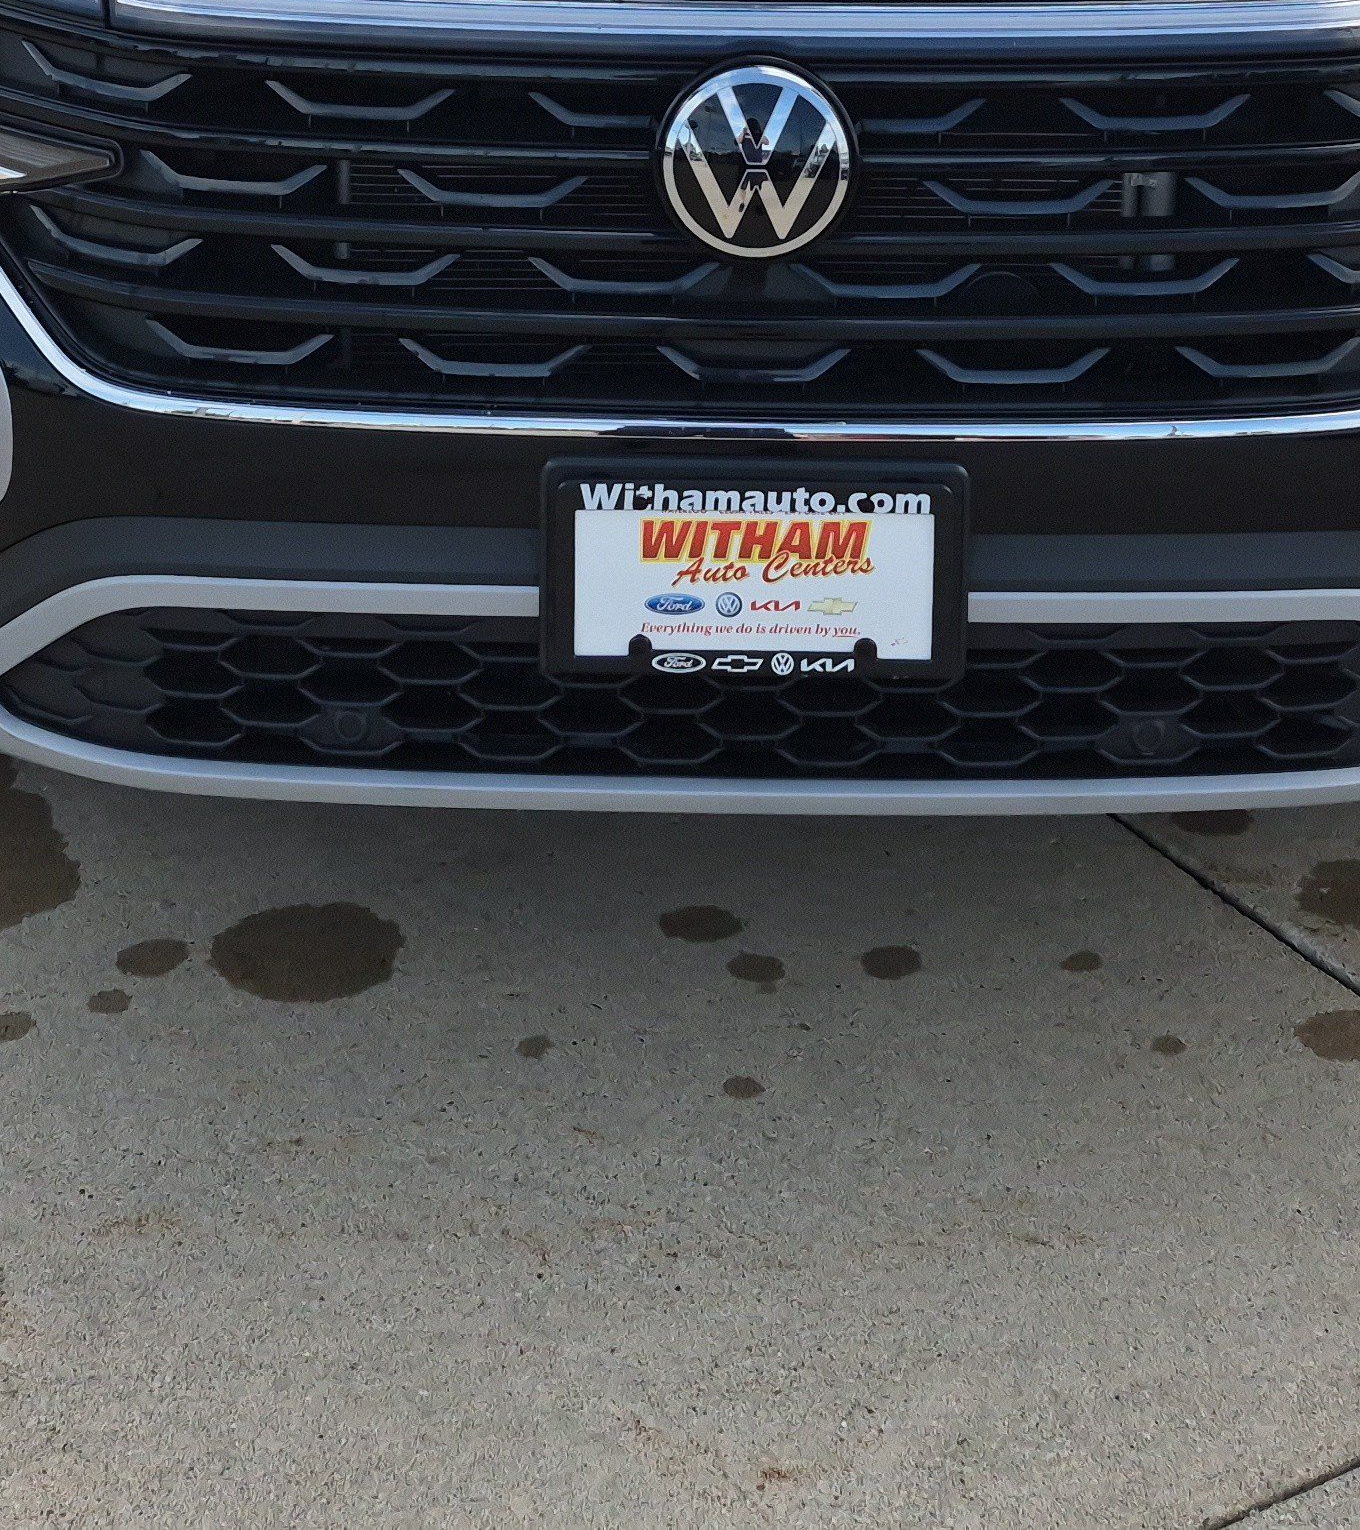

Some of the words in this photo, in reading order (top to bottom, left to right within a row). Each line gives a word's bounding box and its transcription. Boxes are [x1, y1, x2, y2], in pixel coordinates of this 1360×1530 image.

[579, 482, 931, 514] Withamauto.com
[641, 519, 870, 562] WITHAM
[671, 557, 750, 586] Auto
[762, 551, 875, 583] Centers
[656, 596, 694, 611] Ford
[750, 599, 801, 612] KIA
[641, 622, 713, 636] Everything
[715, 625, 733, 634] we
[736, 623, 752, 635] do
[756, 623, 767, 635] is
[769, 623, 812, 635] driven
[815, 624, 831, 637] by
[832, 625, 860, 638] you.
[663, 656, 694, 669] Ford
[800, 657, 855, 673] KIA
